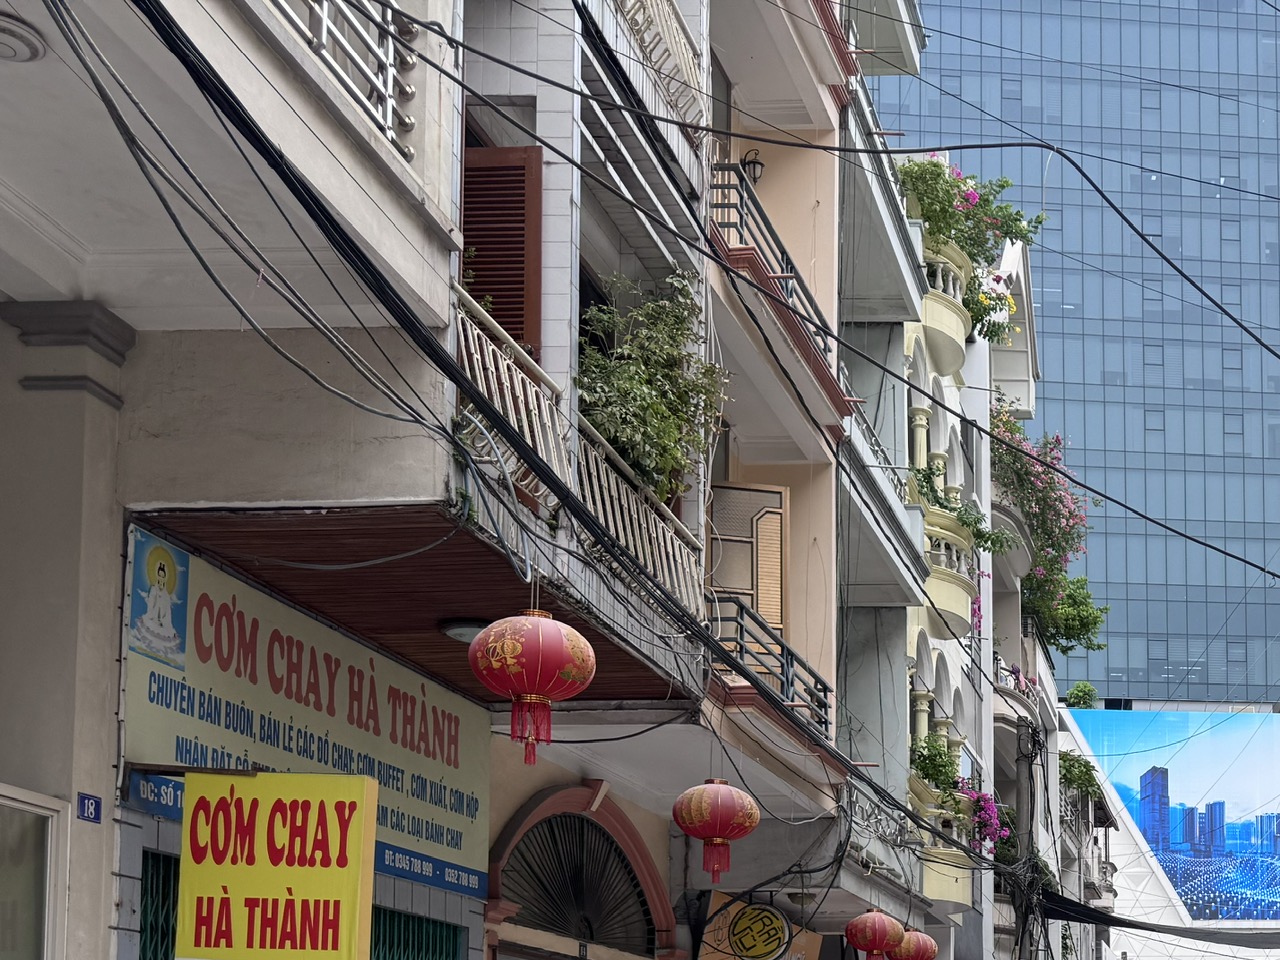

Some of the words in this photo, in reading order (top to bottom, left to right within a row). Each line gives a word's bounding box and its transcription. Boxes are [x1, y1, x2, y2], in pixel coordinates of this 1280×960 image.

[193, 592, 260, 686] CƠM
[267, 628, 341, 717] CHAY
[347, 657, 381, 737] HÀ
[387, 682, 460, 769] THÀNH
[148, 670, 196, 717] CHUYÊN
[198, 687, 222, 727] BÁN
[224, 700, 256, 744] BUÔN,
[259, 711, 280, 749] BÁN
[282, 716, 294, 754] LẺ
[296, 724, 315, 761] CÁC
[317, 729, 330, 766] ĐỒ
[356, 752, 376, 778] CƠM
[377, 760, 405, 794] BUFFET
[411, 773, 428, 802] CƠM
[449, 787, 465, 817] CƠM
[466, 791, 479, 826] HỘP
[84, 799, 96, 819] 18
[160, 781, 174, 806] SỐ
[176, 789, 185, 809] 1
[189, 783, 260, 867] CƠM
[266, 797, 358, 869] CHAY
[390, 805, 406, 834] CÁC
[407, 816, 424, 842] LOẠI
[425, 817, 445, 846] BÁNH
[446, 827, 464, 851] CHAY
[384, 849, 394, 865] ĐT:
[394, 852, 410, 870] 0345
[410, 856, 421, 874] 788
[422, 859, 433, 877] 999
[444, 867, 458, 884] 0352
[458, 871, 468, 887] 788
[468, 873, 479, 889] 999
[193, 885, 233, 948] HÀ
[244, 886, 341, 951] THÀNH
